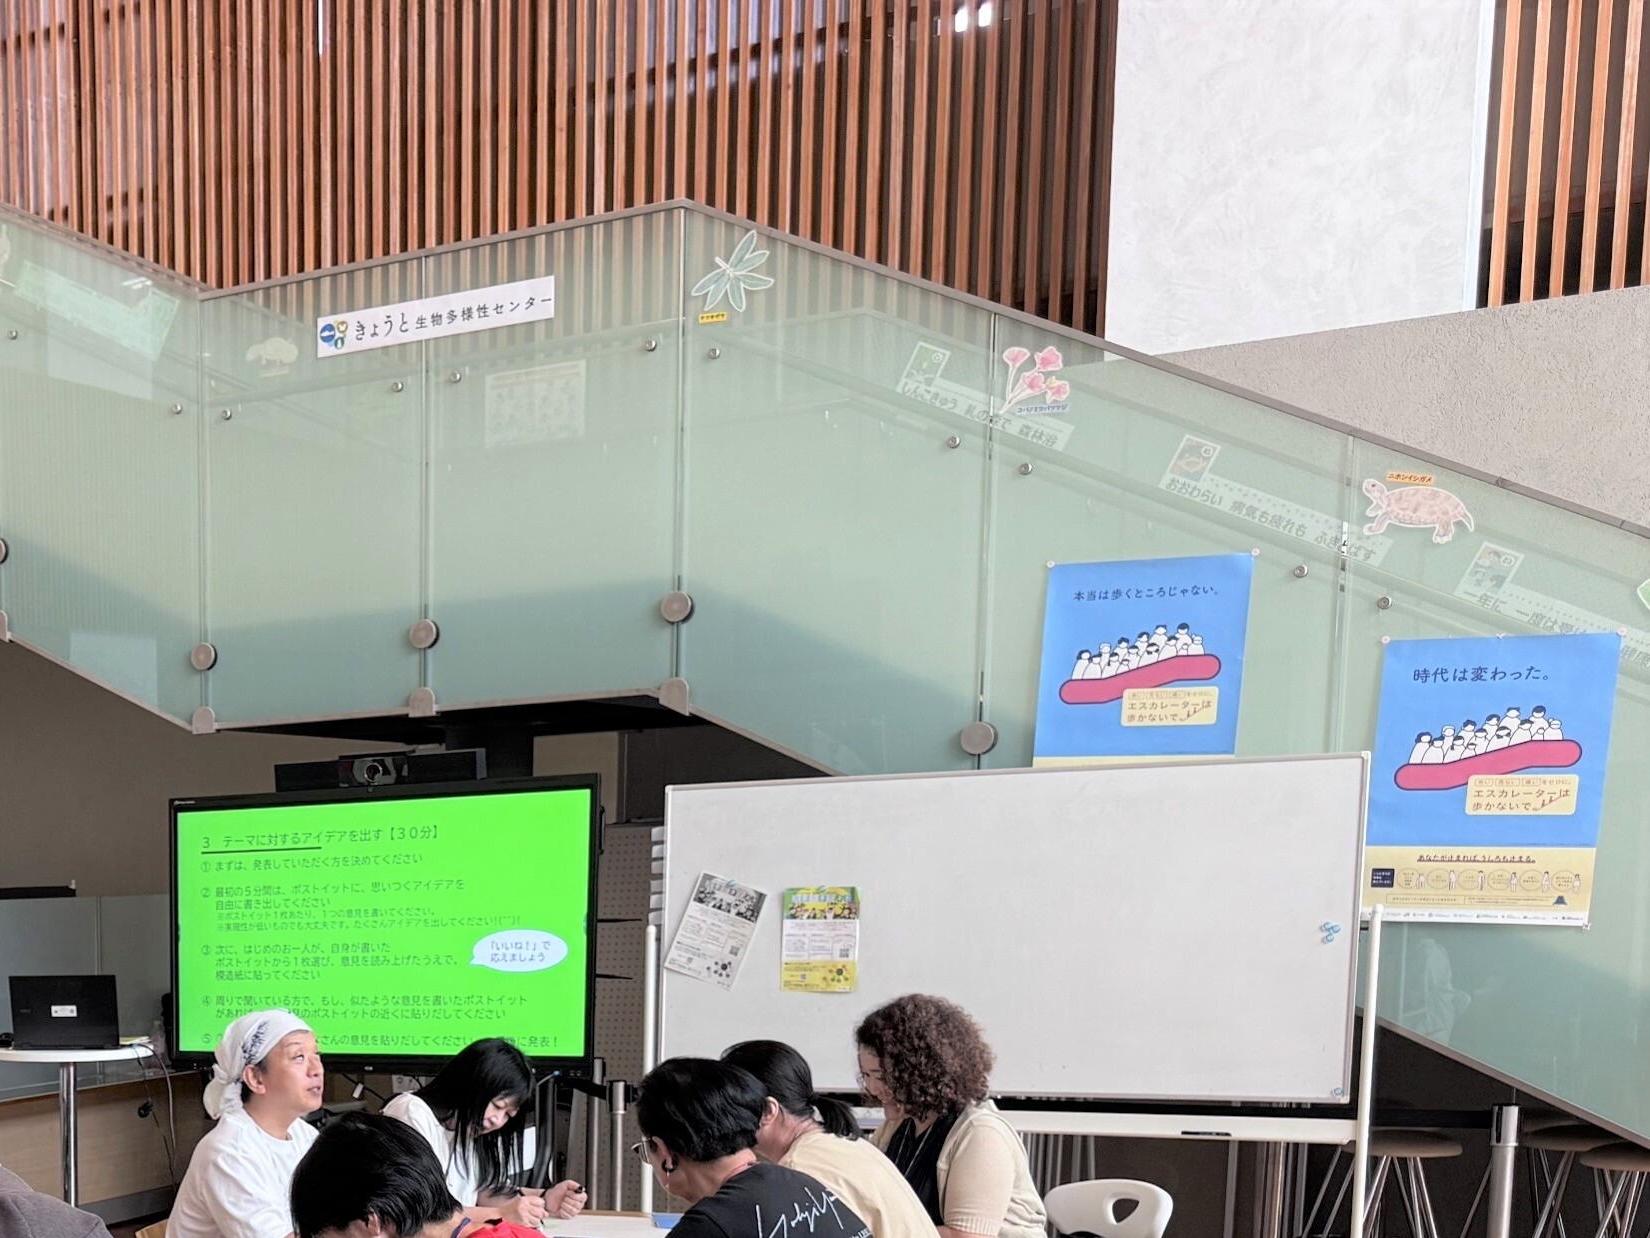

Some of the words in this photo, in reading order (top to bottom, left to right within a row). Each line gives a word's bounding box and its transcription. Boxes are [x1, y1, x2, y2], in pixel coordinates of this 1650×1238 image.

[1387, 472, 1433, 483] ニホンイシガメ
[1165, 477, 1224, 507] おおわらい
[1228, 501, 1307, 538] 病気も疲れも
[1073, 584, 1219, 602] 本当は歩くところじゃない。
[1412, 665, 1550, 684] 時代は変わった。
[1127, 700, 1211, 711] エスカレーターは
[1473, 788, 1571, 799] エスカレーターは
[202, 837, 211, 849] 3
[215, 853, 423, 872] まずは、発表していただく方を決めてください
[215, 898, 331, 911] 自由に書き出してください
[215, 942, 391, 955] 次に、はじめのお一人が、自身が書いた
[215, 955, 458, 967] ポストイットから1枚選び、意見を読み上げたうえで、
[490, 953, 546, 963] 応えましょう
[215, 970, 321, 981] 模造紙に貼ってください
[215, 994, 528, 1007] 周りで聞いている方で、もし、似たような意見を書いたポストイット
